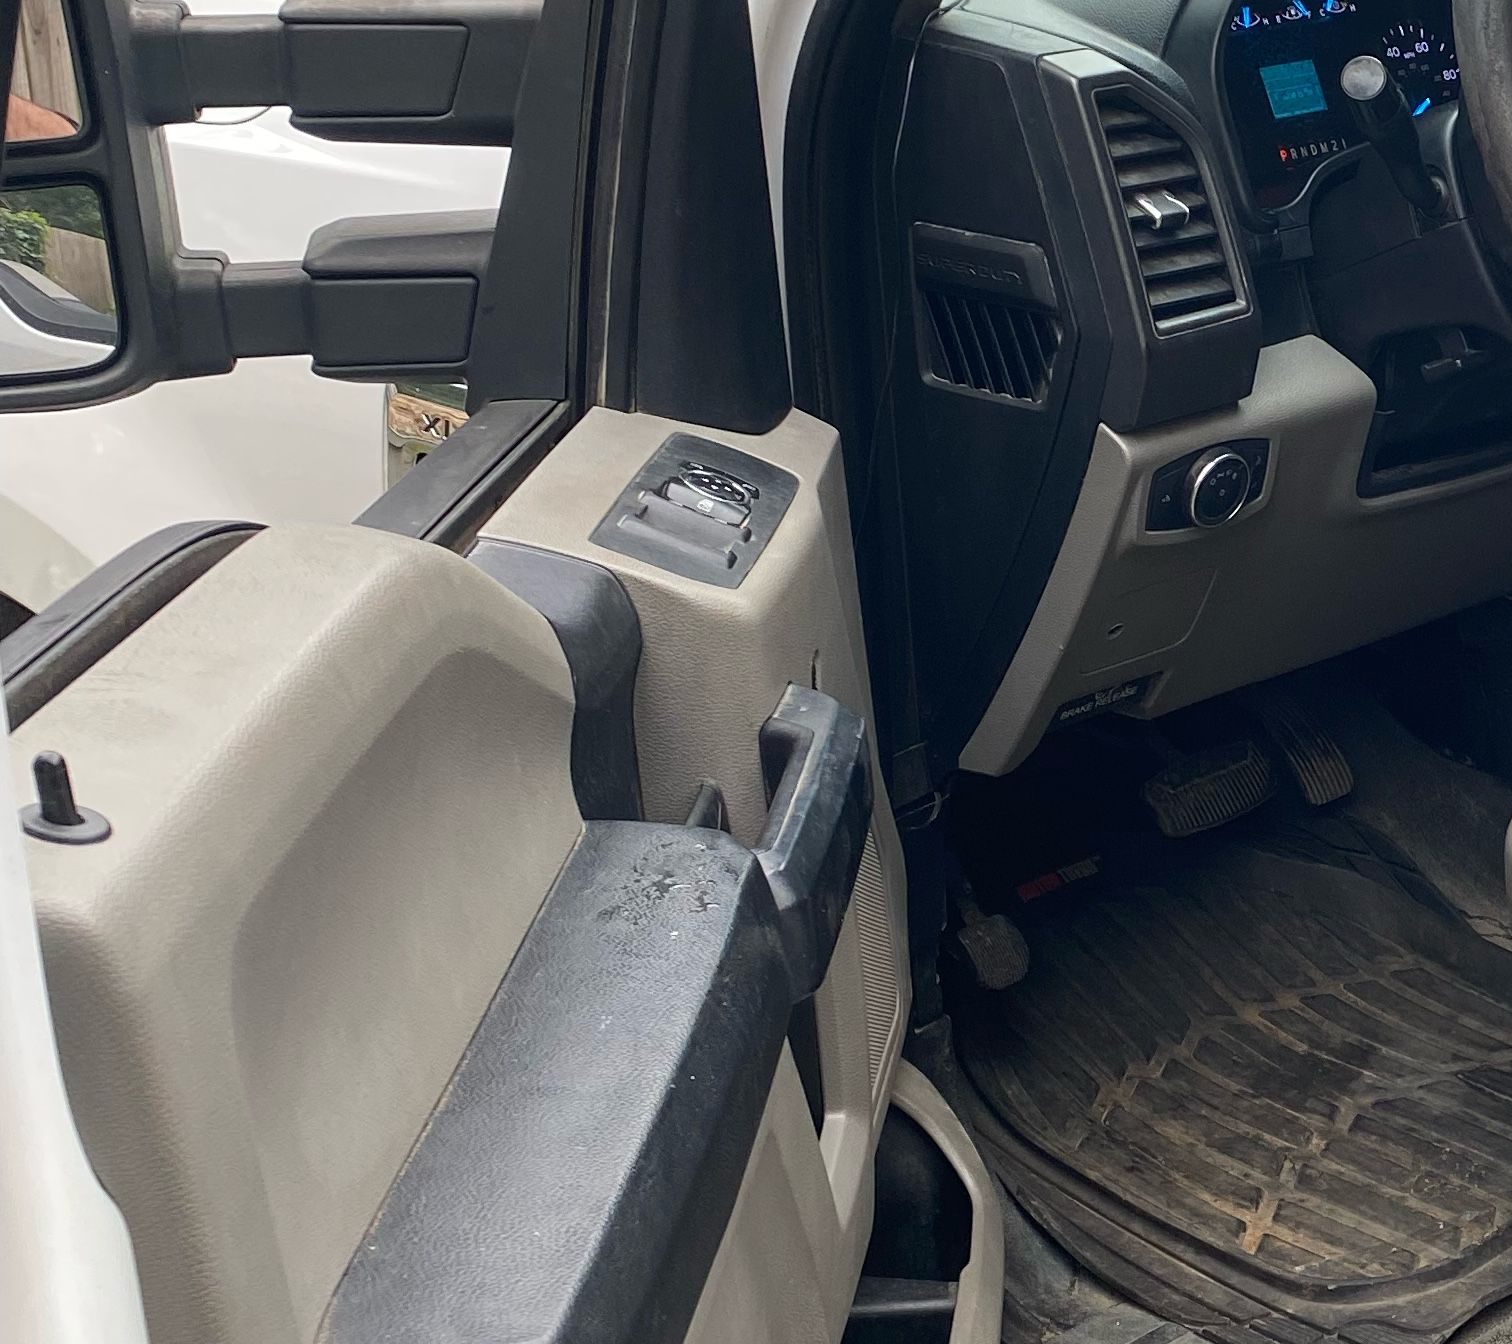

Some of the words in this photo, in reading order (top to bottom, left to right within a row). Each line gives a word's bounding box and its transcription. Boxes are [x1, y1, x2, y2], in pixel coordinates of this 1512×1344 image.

[1386, 46, 1401, 58] 40
[1414, 41, 1429, 53] 60
[1442, 68, 1457, 81] 80
[1059, 702, 1094, 720] BRAKE
[1095, 686, 1137, 708] RELEASE
